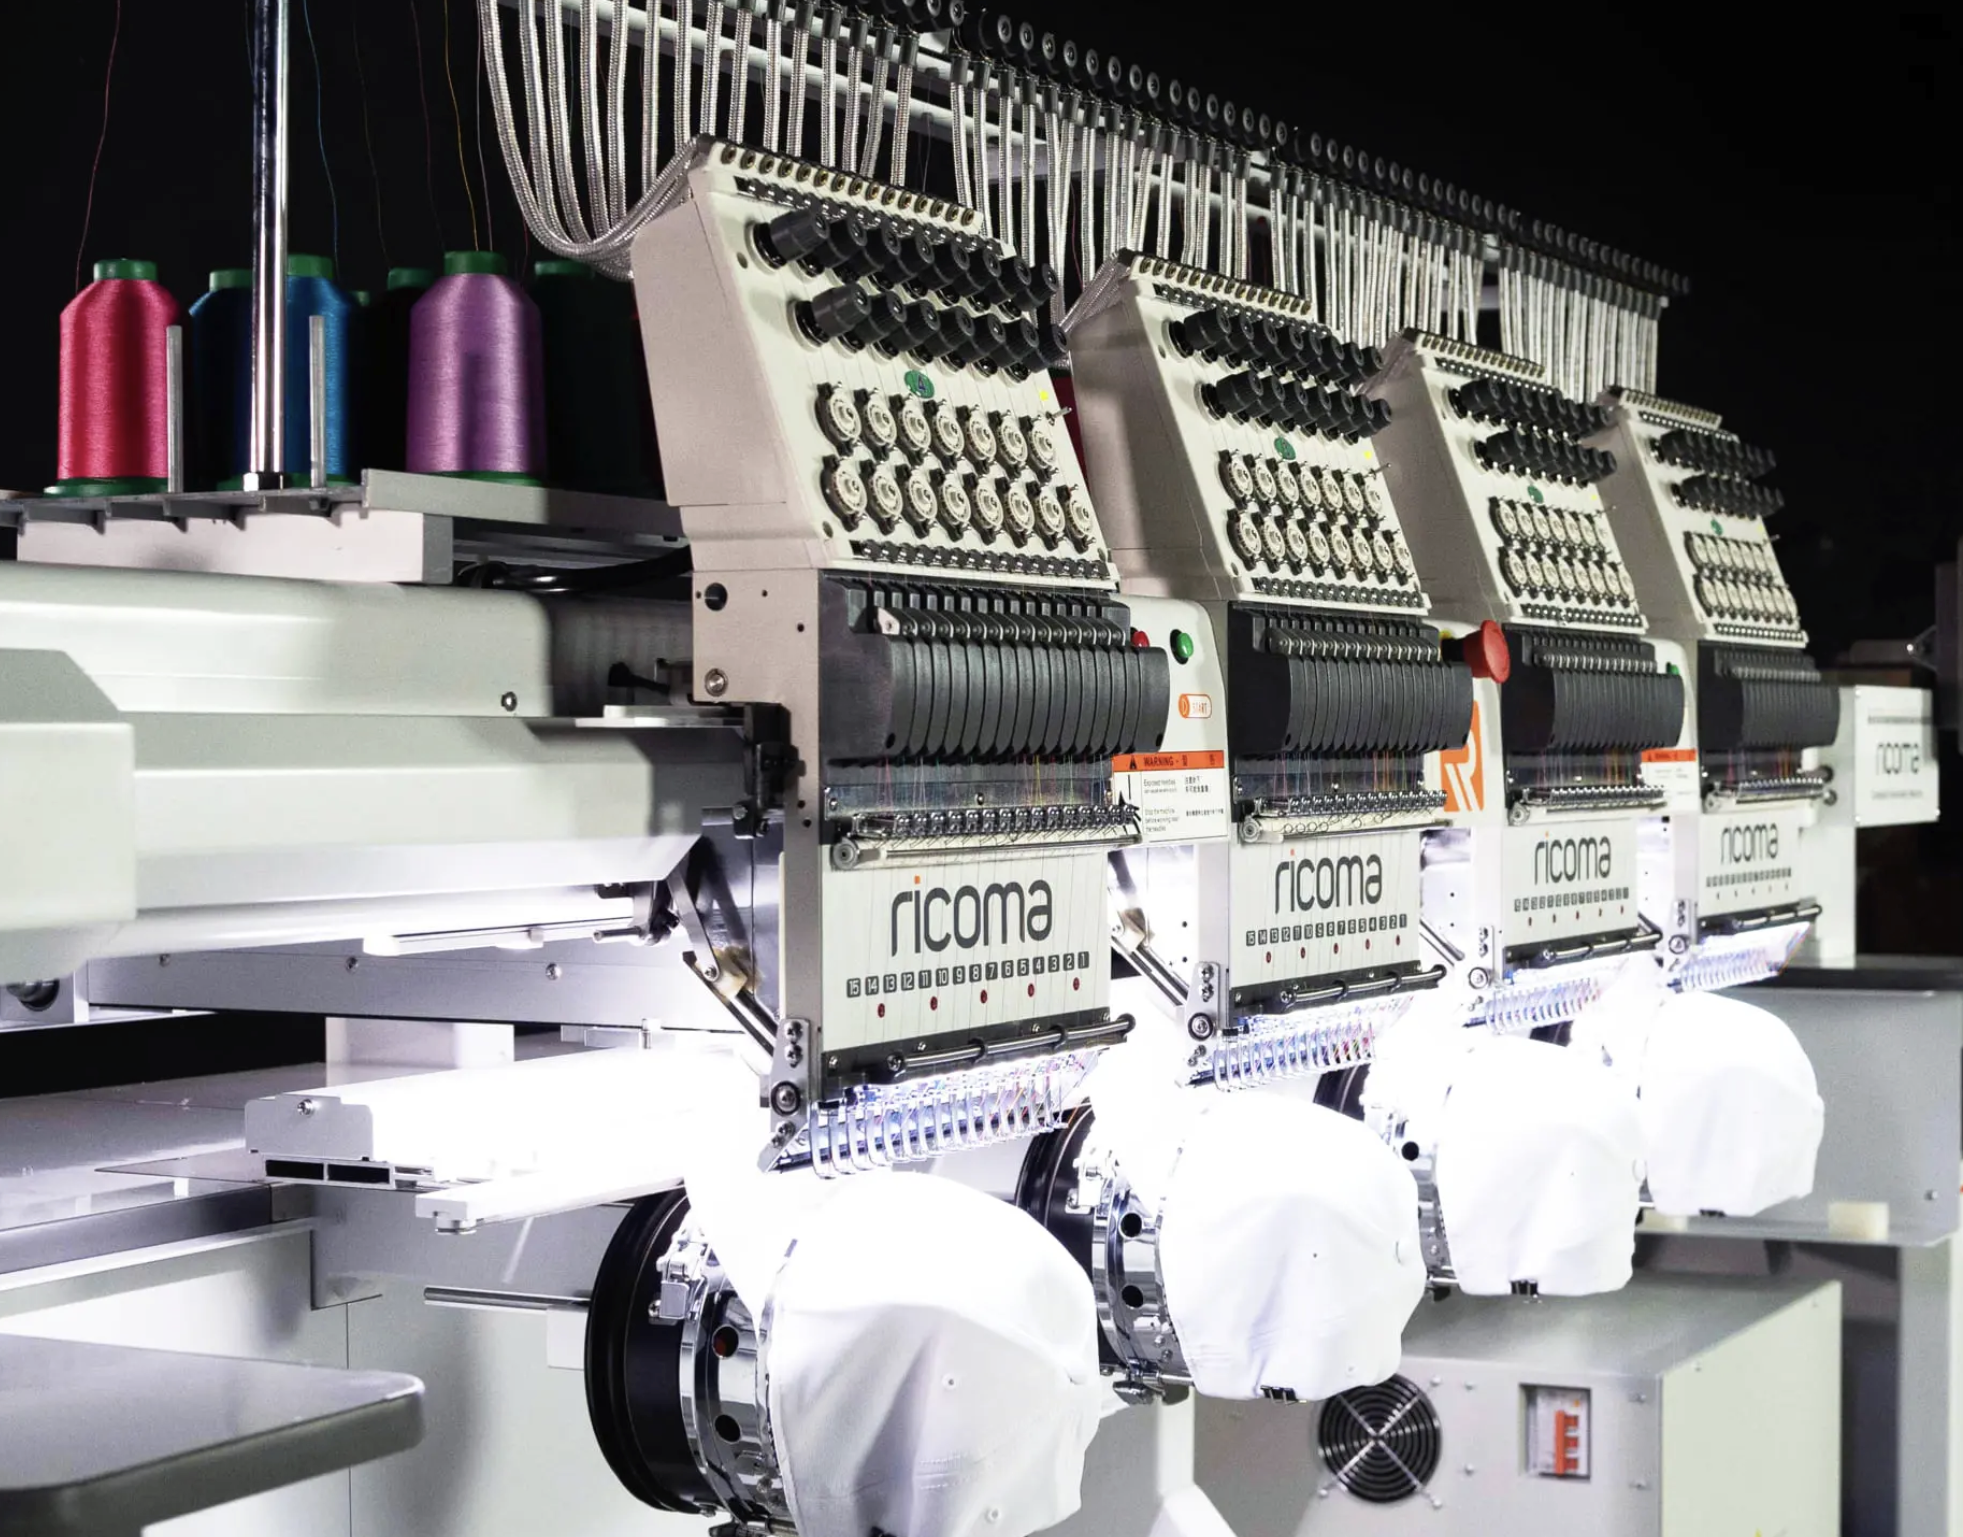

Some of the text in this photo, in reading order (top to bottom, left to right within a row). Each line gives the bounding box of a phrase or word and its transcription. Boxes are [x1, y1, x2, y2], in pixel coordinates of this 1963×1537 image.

[1143, 755, 1174, 767] WARNING
[1534, 830, 1611, 886] ricoma
[1720, 819, 1779, 865] ricoma
[1275, 848, 1382, 914] ricoma
[891, 875, 1053, 957] ricoma
[1247, 933, 1254, 945] 15
[1271, 930, 1278, 942] 13
[1283, 928, 1289, 940] 12
[848, 980, 859, 996] 15
[867, 978, 877, 994] 14
[885, 976, 895, 991] 13
[903, 974, 913, 989] 12
[920, 972, 930, 987] 11
[937, 970, 947, 985] 10
